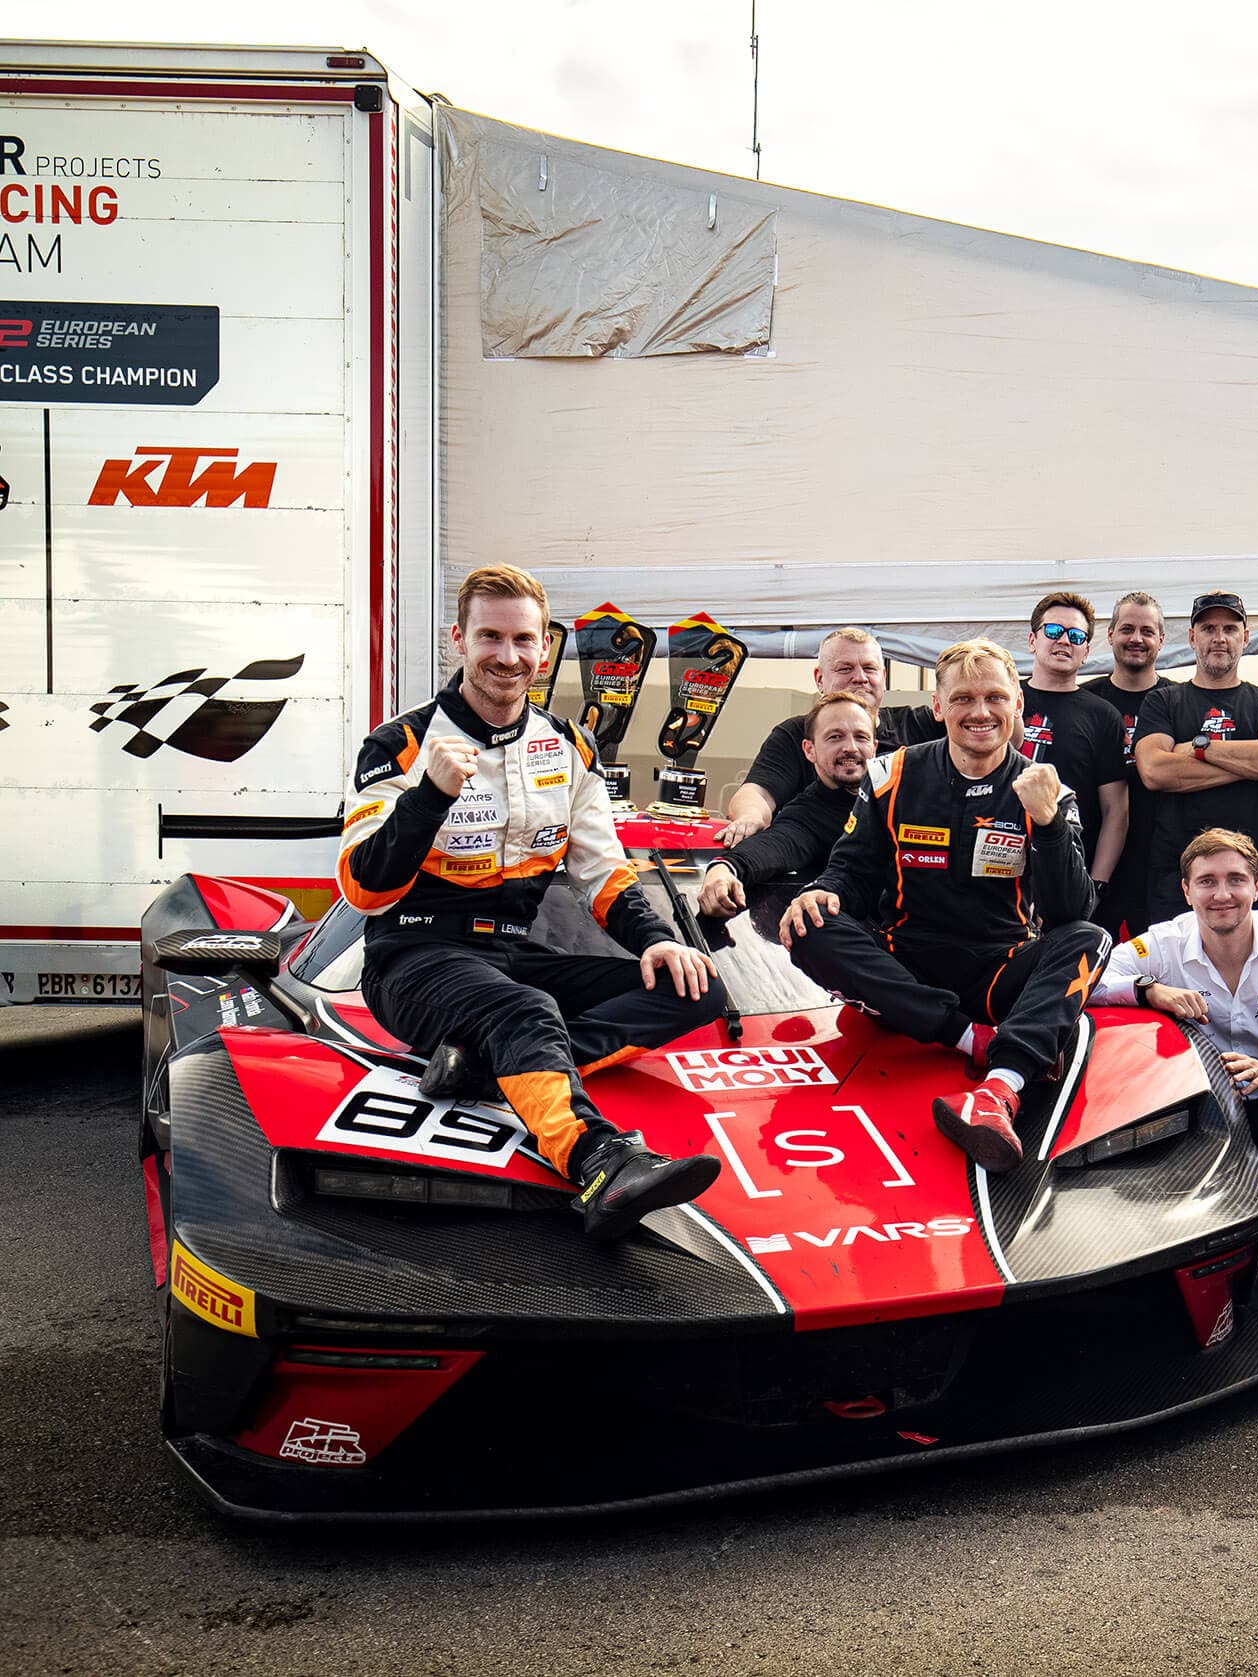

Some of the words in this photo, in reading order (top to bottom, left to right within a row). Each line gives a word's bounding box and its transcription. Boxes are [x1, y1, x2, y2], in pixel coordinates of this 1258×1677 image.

[36, 156, 161, 178] PROJECTS
[0, 183, 118, 225] CING
[40, 320, 157, 336] EUROPEAN
[36, 335, 113, 349] SERIES
[0, 364, 74, 384] CLASS
[81, 366, 197, 387] CHAMPION
[88, 446, 277, 508] KTM
[527, 738, 560, 753] GT2
[965, 784, 994, 797] KTM
[450, 834, 492, 845] XTAL
[904, 828, 946, 842] PIRELLI
[984, 832, 1024, 849] GT2
[981, 850, 1007, 858] SERIES
[983, 844, 1022, 855] EUROPEAN
[446, 858, 492, 871] PIRELLI
[917, 855, 946, 863] ORLEN
[675, 1049, 815, 1070] LIQUI
[687, 1066, 825, 1090] MOLY
[335, 1091, 518, 1153] 89
[793, 1218, 973, 1247] VARS
[173, 1255, 244, 1328] PIRELLI
